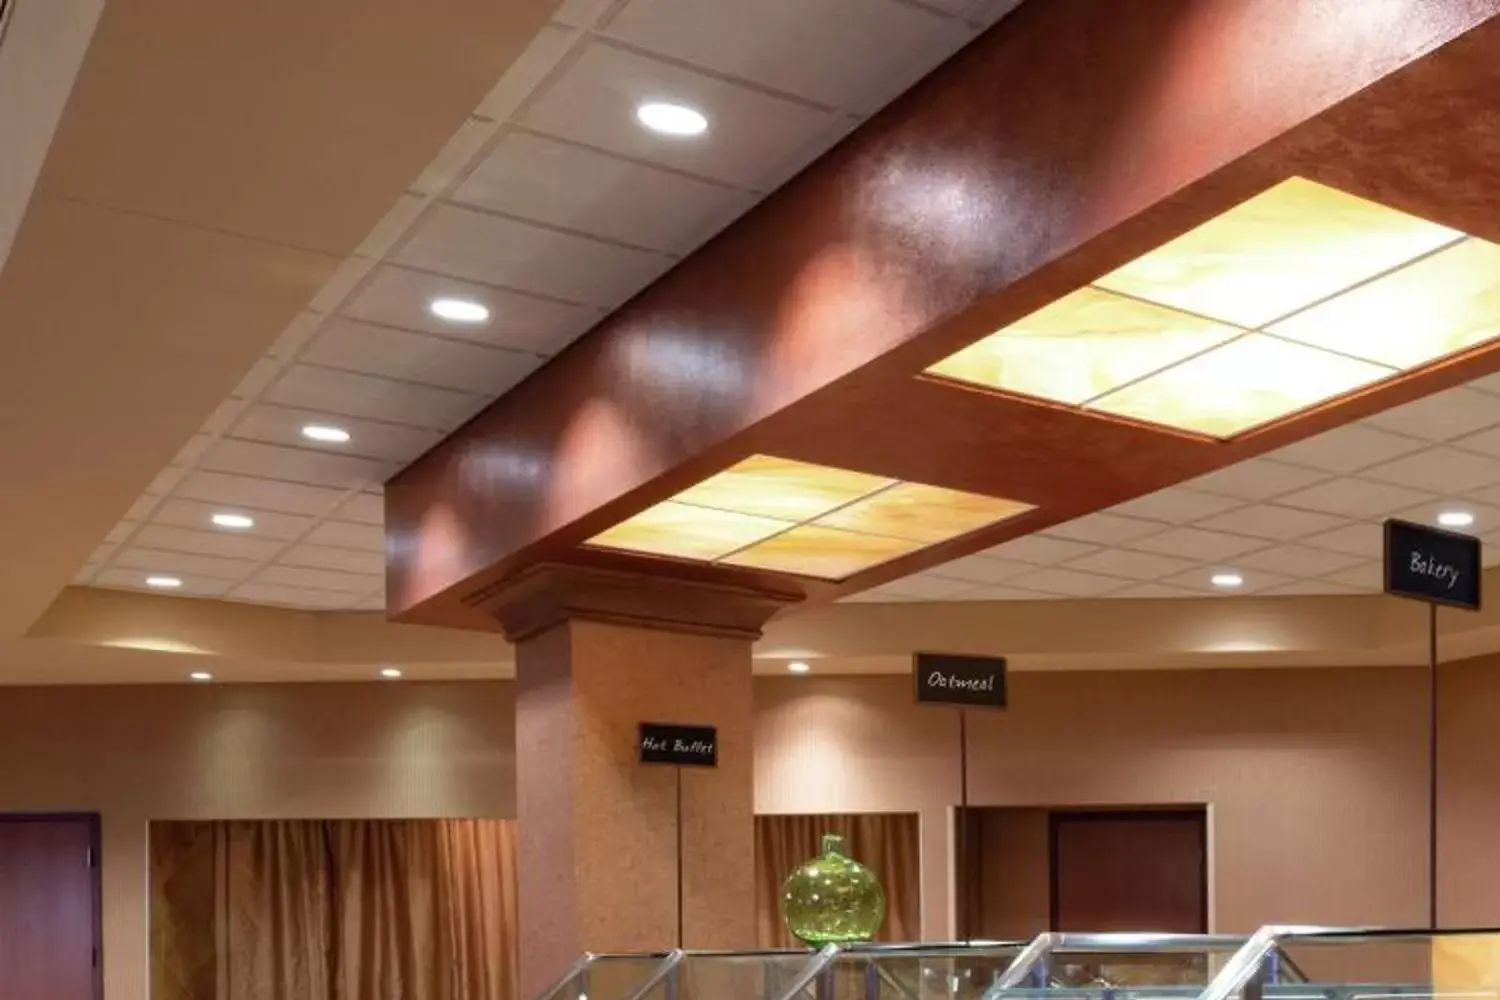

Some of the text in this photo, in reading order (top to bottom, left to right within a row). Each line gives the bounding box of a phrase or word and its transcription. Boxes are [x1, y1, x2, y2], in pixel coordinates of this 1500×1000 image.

[1410, 551, 1459, 589] Bakery
[927, 671, 995, 692] Oatmeal
[642, 736, 714, 754] Hot Buffet
